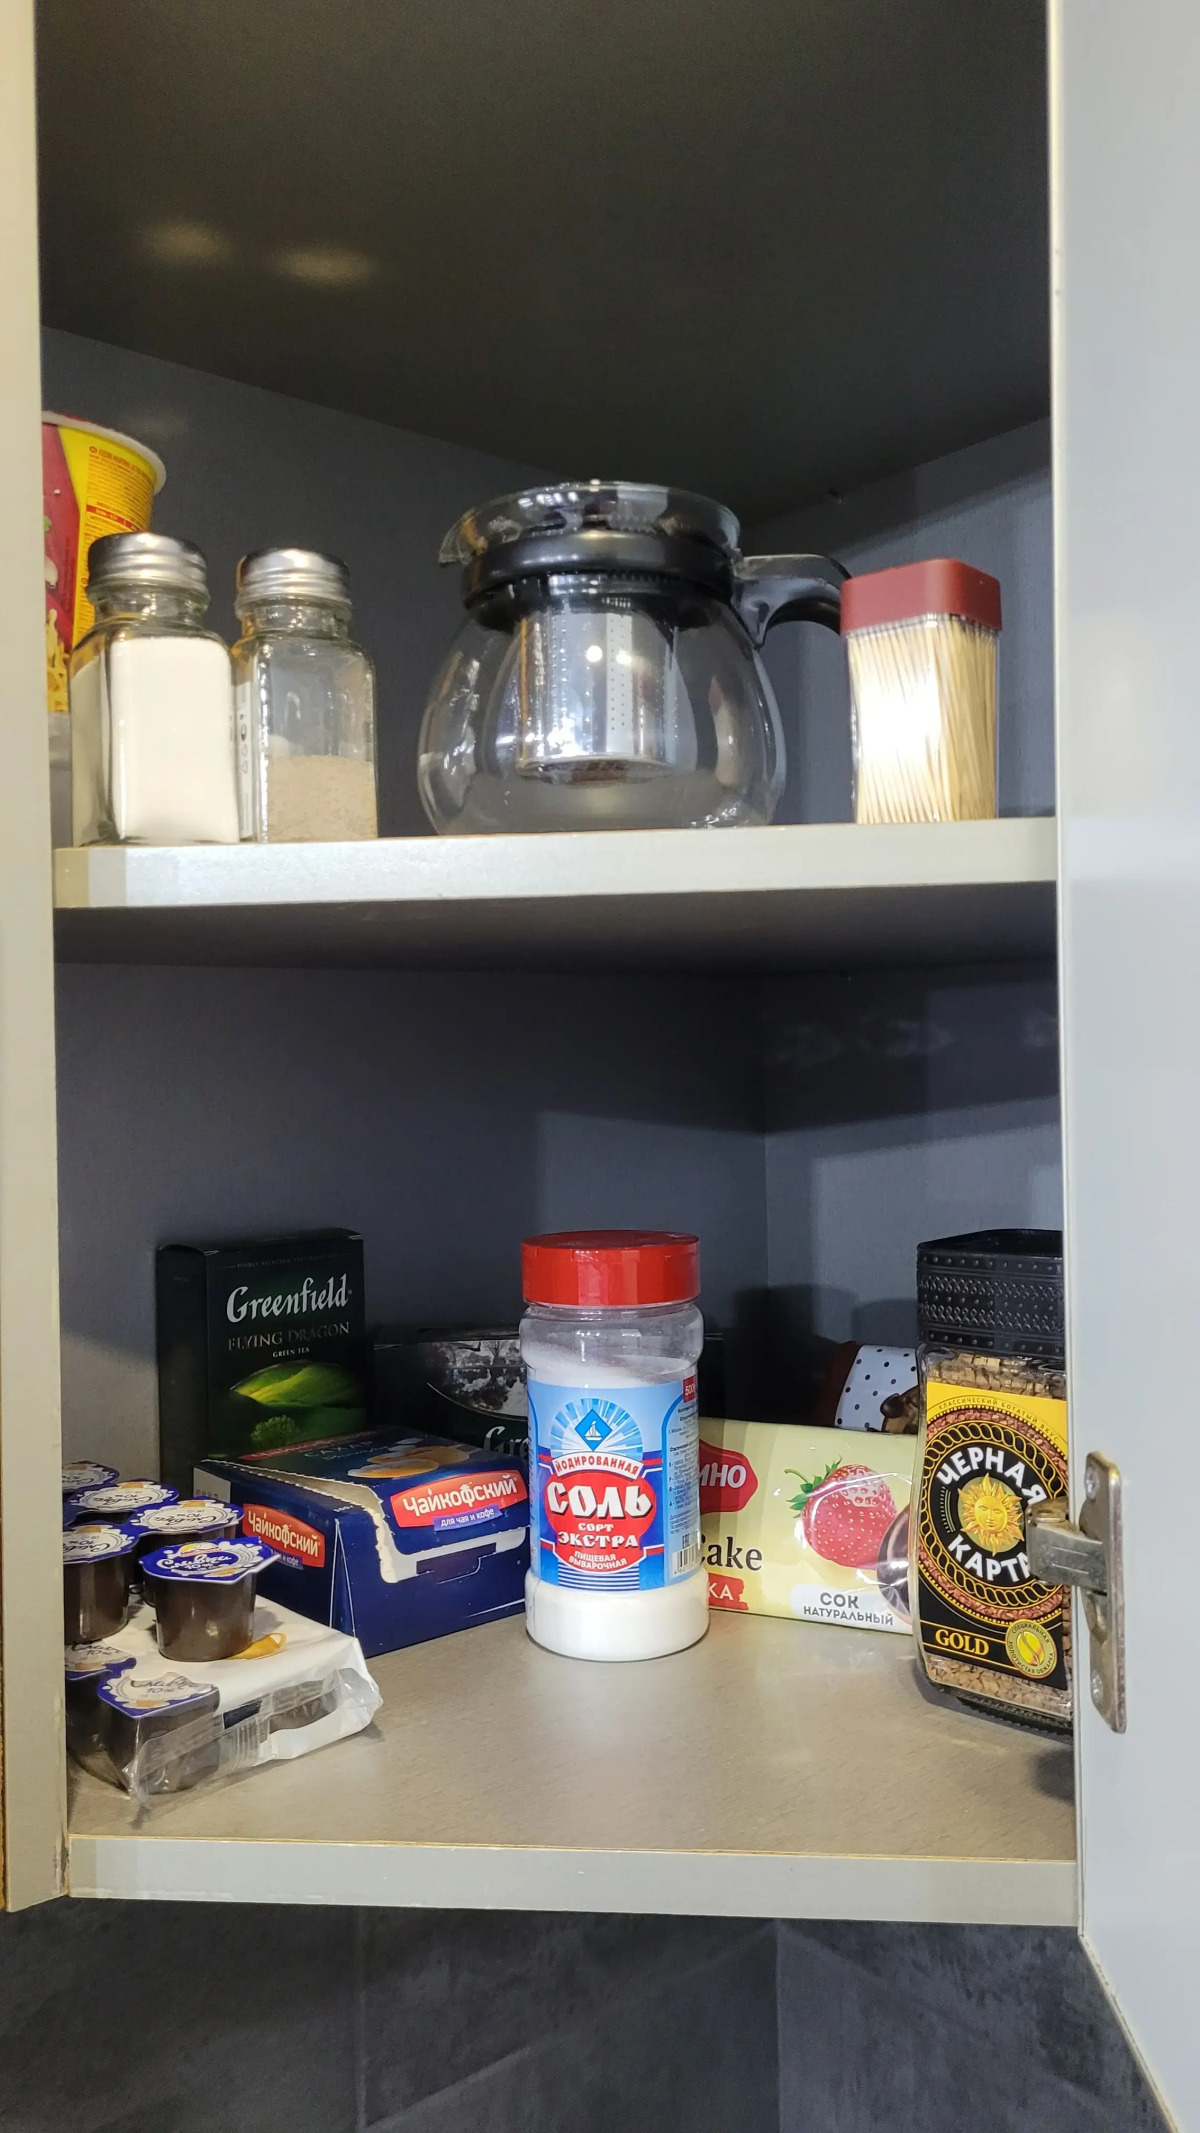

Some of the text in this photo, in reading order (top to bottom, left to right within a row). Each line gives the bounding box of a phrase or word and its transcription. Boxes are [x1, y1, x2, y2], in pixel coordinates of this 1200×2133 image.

[226, 1273, 348, 1323] Greenfield
[228, 1321, 350, 1351] FLYING DRAGON
[272, 1346, 310, 1358] GREEN TEA
[938, 1397, 1059, 1441] КЛАССИЧЕСКИЙ БОГАТЫЙ ВКУС
[555, 1455, 640, 1476] ЙОДИРОВАННАЯ
[936, 1446, 1047, 1506] ЧЕРНАЯ
[402, 1474, 518, 1517] Чайкофский
[547, 1481, 653, 1519] СОЛЬ
[440, 1517, 456, 1527] для
[456, 1514, 470, 1525] чая
[476, 1507, 495, 1521] кофе
[577, 1522, 614, 1533] СОРТ
[248, 1510, 319, 1558] Чайкофский
[558, 1531, 640, 1548] ЭКСТРА
[286, 1556, 299, 1567] кофе
[568, 1556, 628, 1570] ВЫВАРОЧНАЯ
[574, 1551, 617, 1562] ПИЩЕВАЯ
[819, 1592, 860, 1609] СОК
[803, 1605, 894, 1626] НАТУРАЛЬНЫЙ
[935, 1629, 990, 1656] GOLD
[1011, 1623, 1050, 1644] СПЕЦИАЛЬНАЯ
[1036, 1652, 1054, 1675] ОБЖАРКА
